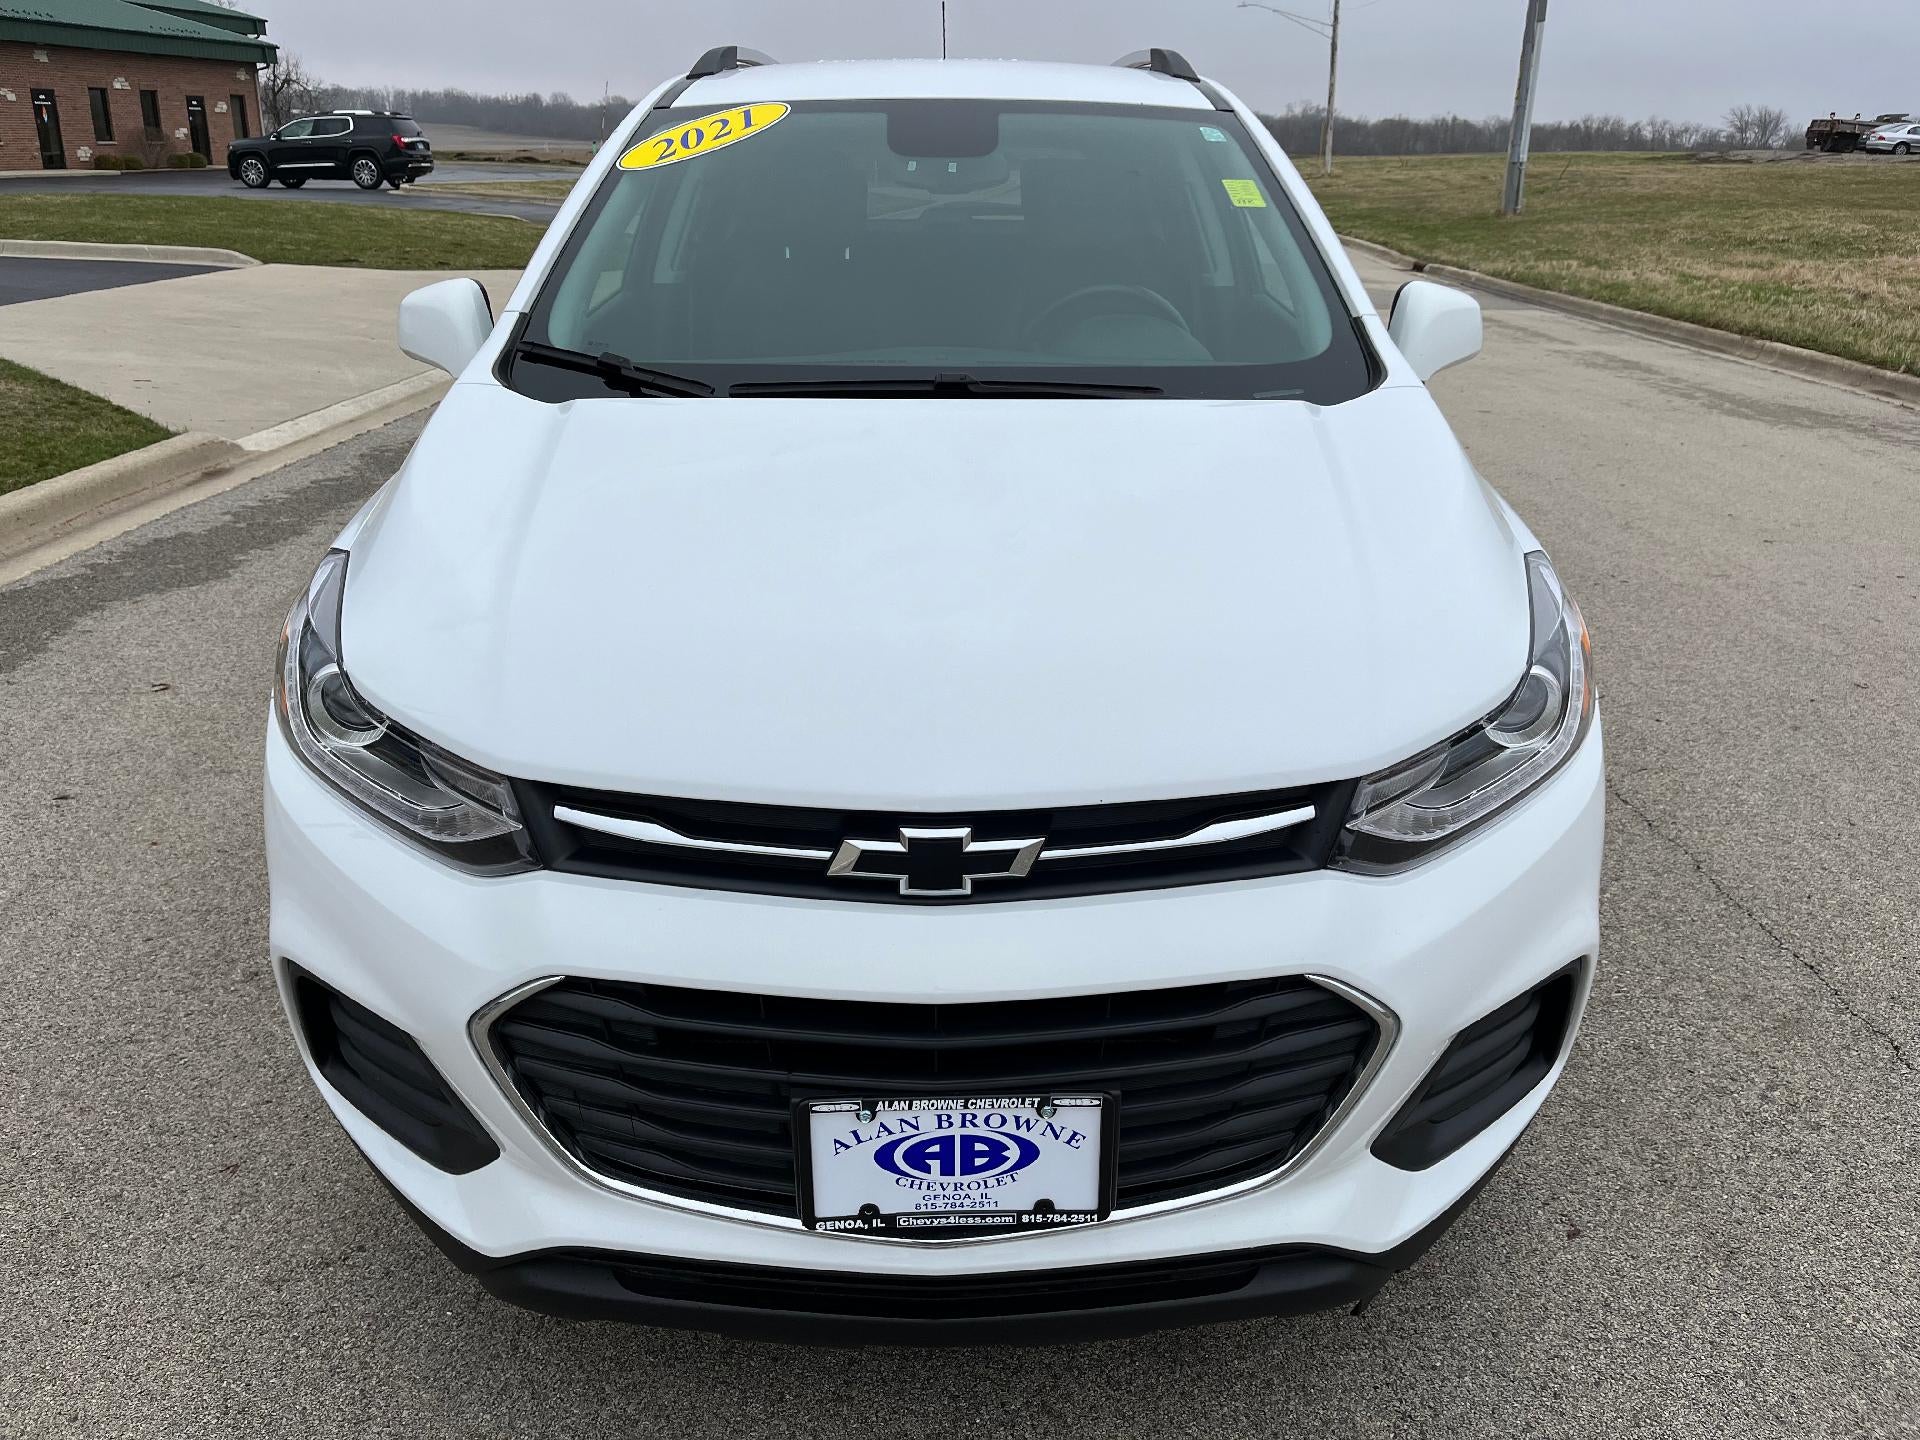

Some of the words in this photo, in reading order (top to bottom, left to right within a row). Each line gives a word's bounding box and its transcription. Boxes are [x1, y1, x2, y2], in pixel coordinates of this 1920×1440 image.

[653, 108, 757, 162] 2021
[875, 1100, 910, 1112] ALAN
[911, 1098, 965, 1111] BROWNE
[967, 1097, 1040, 1110] CHEVROLET
[832, 1115, 920, 1156] ALAN
[935, 1112, 1087, 1151] BROWNE
[895, 1171, 1019, 1192] CHEVROLET
[922, 1193, 976, 1201] GENOA,
[914, 1200, 999, 1210] 815-784-2511
[815, 1219, 868, 1231] GENOA,
[872, 1218, 885, 1228] IL
[899, 1214, 1014, 1226] Chevys4less.com
[1021, 1213, 1098, 1224] 815-784-2511
